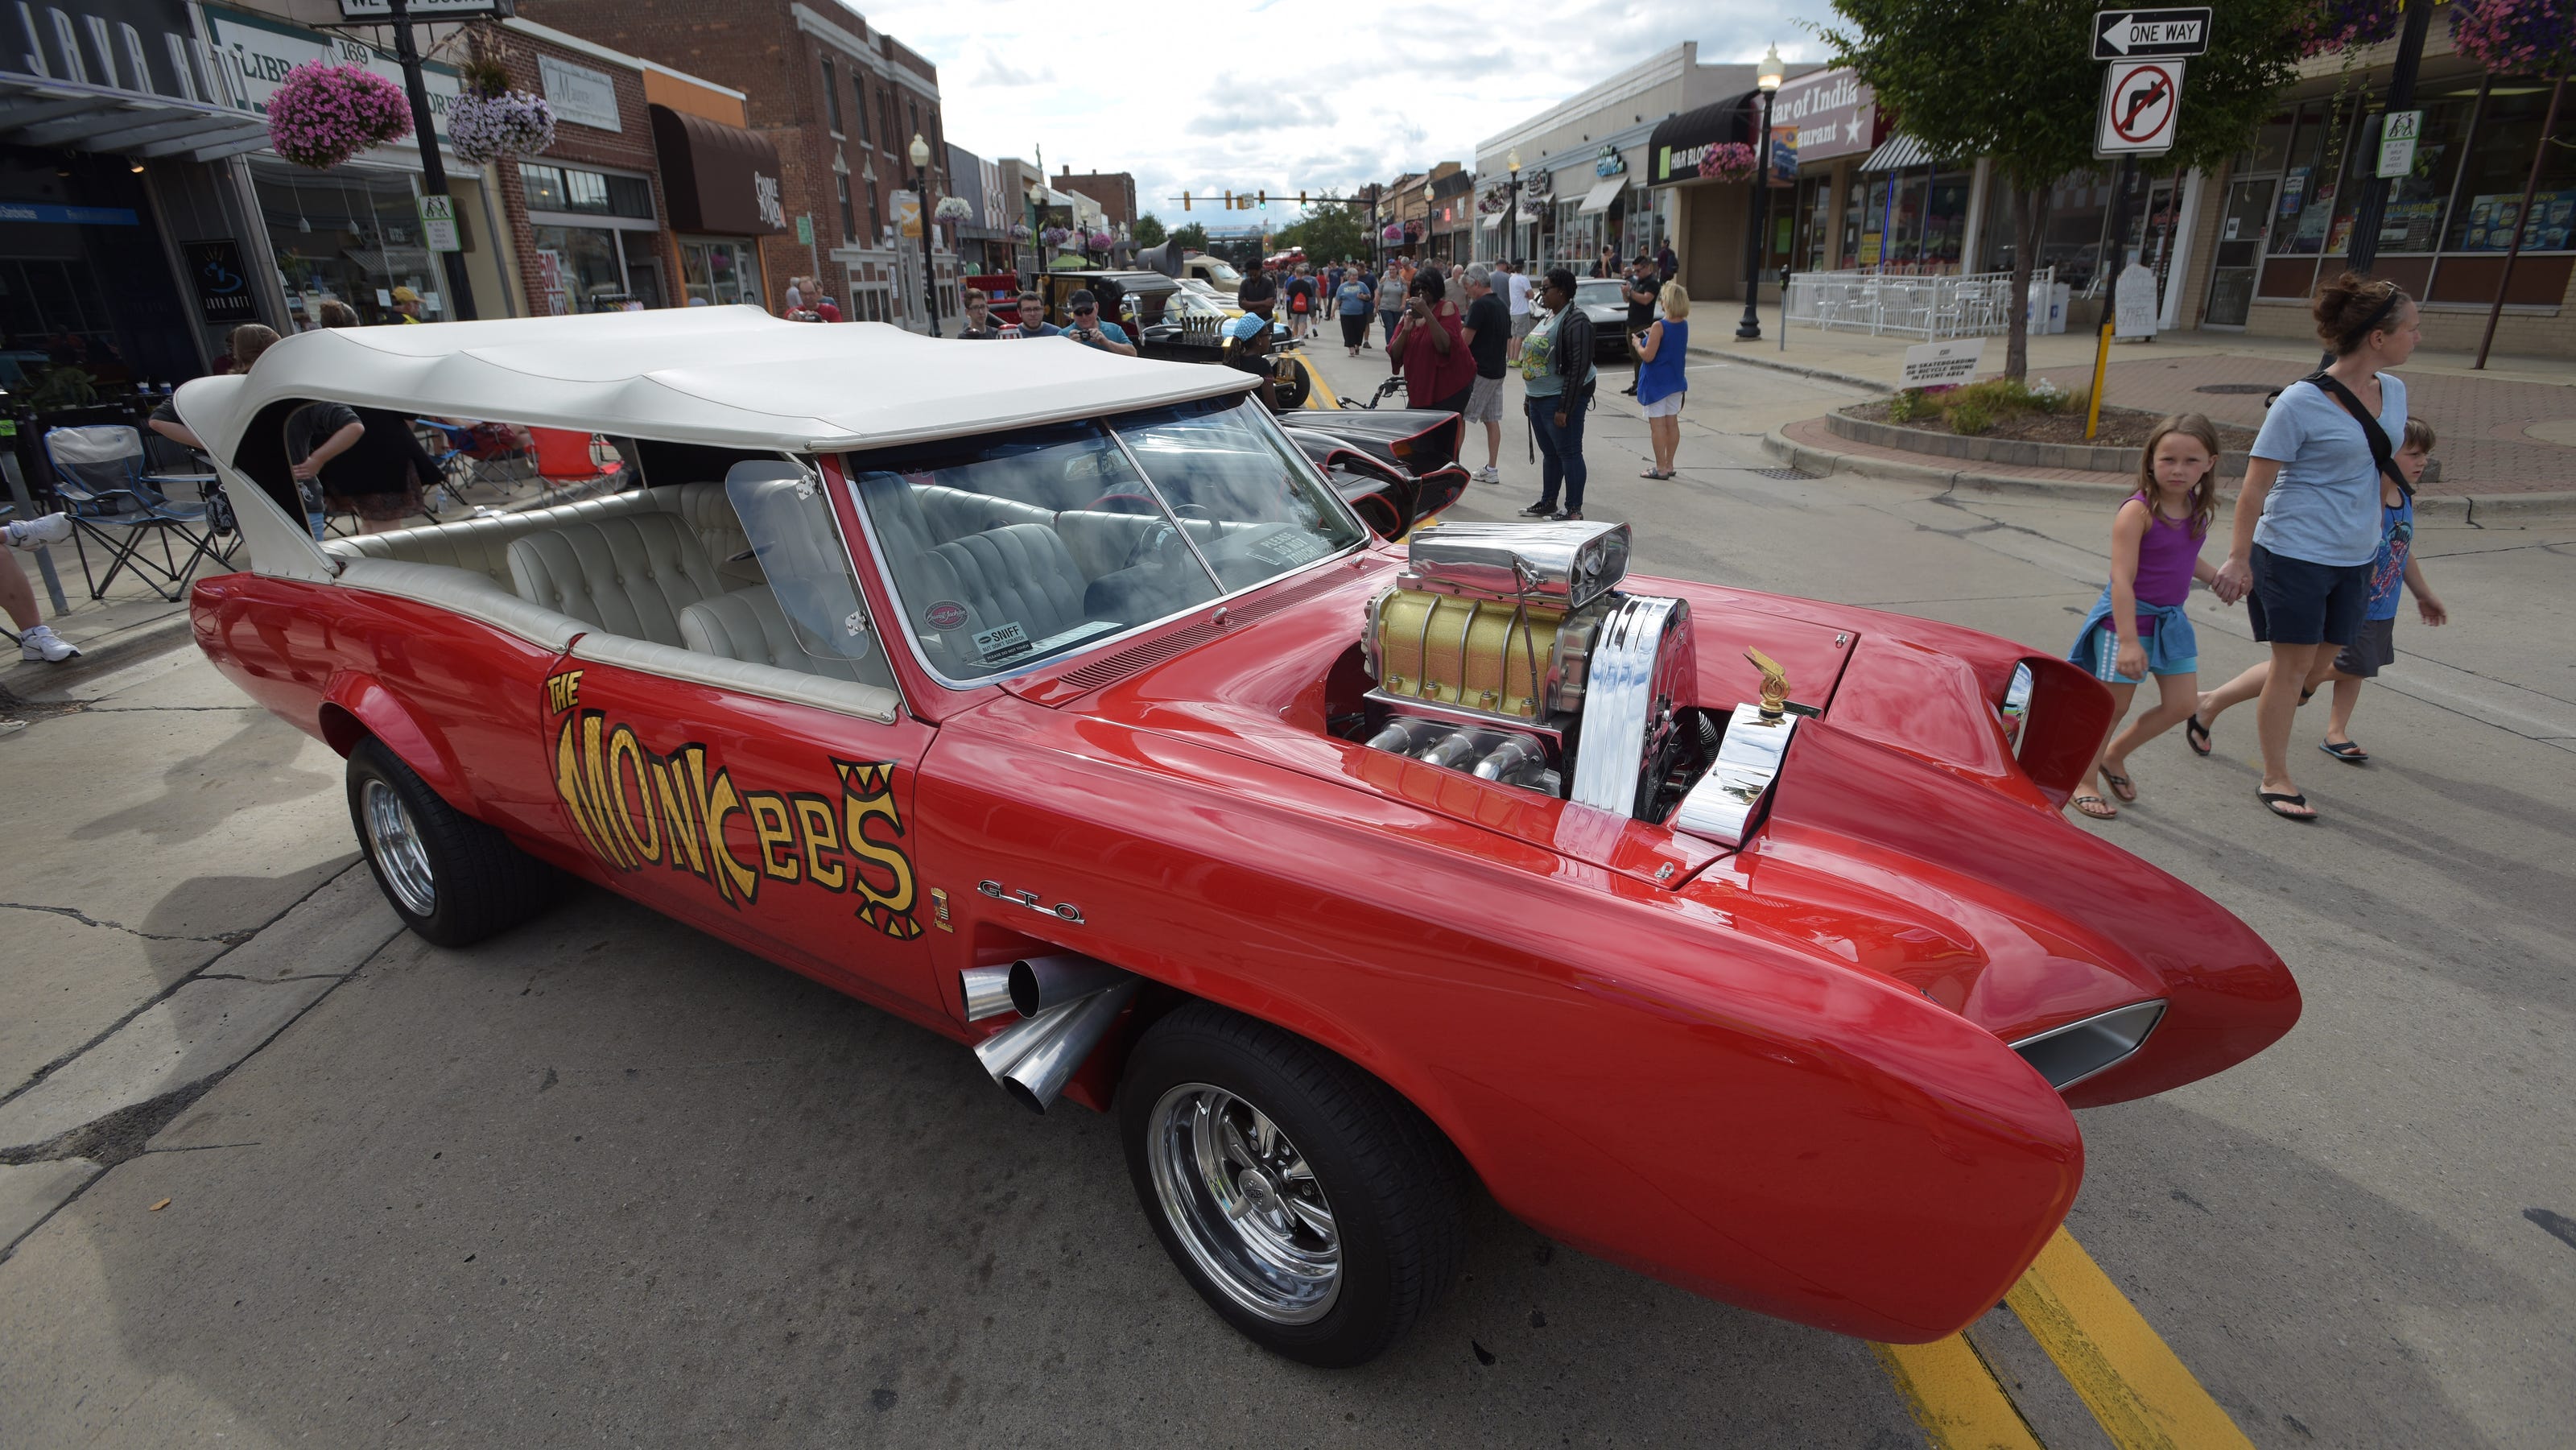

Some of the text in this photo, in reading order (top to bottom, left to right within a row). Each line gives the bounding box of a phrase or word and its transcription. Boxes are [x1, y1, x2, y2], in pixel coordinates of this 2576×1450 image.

[2130, 23, 2197, 43] ONE WAY
[15, 1, 255, 113] JAVA HUTT
[233, 43, 303, 83] LIBR
[338, 40, 368, 64] 169
[1761, 77, 1858, 127] tar of India
[1797, 121, 1837, 150] aurant
[1671, 150, 1687, 171] H&R
[1918, 357, 1977, 369] SKATEBOARDING
[1918, 366, 1946, 374] BICYCLE
[991, 625, 1019, 642] SNIFF
[992, 641, 1005, 651] DON'T
[1005, 635, 1025, 646] SCRATCH
[1016, 643, 1030, 651] TOUCH
[547, 670, 584, 715] THE
[977, 879, 1081, 921] GTO
